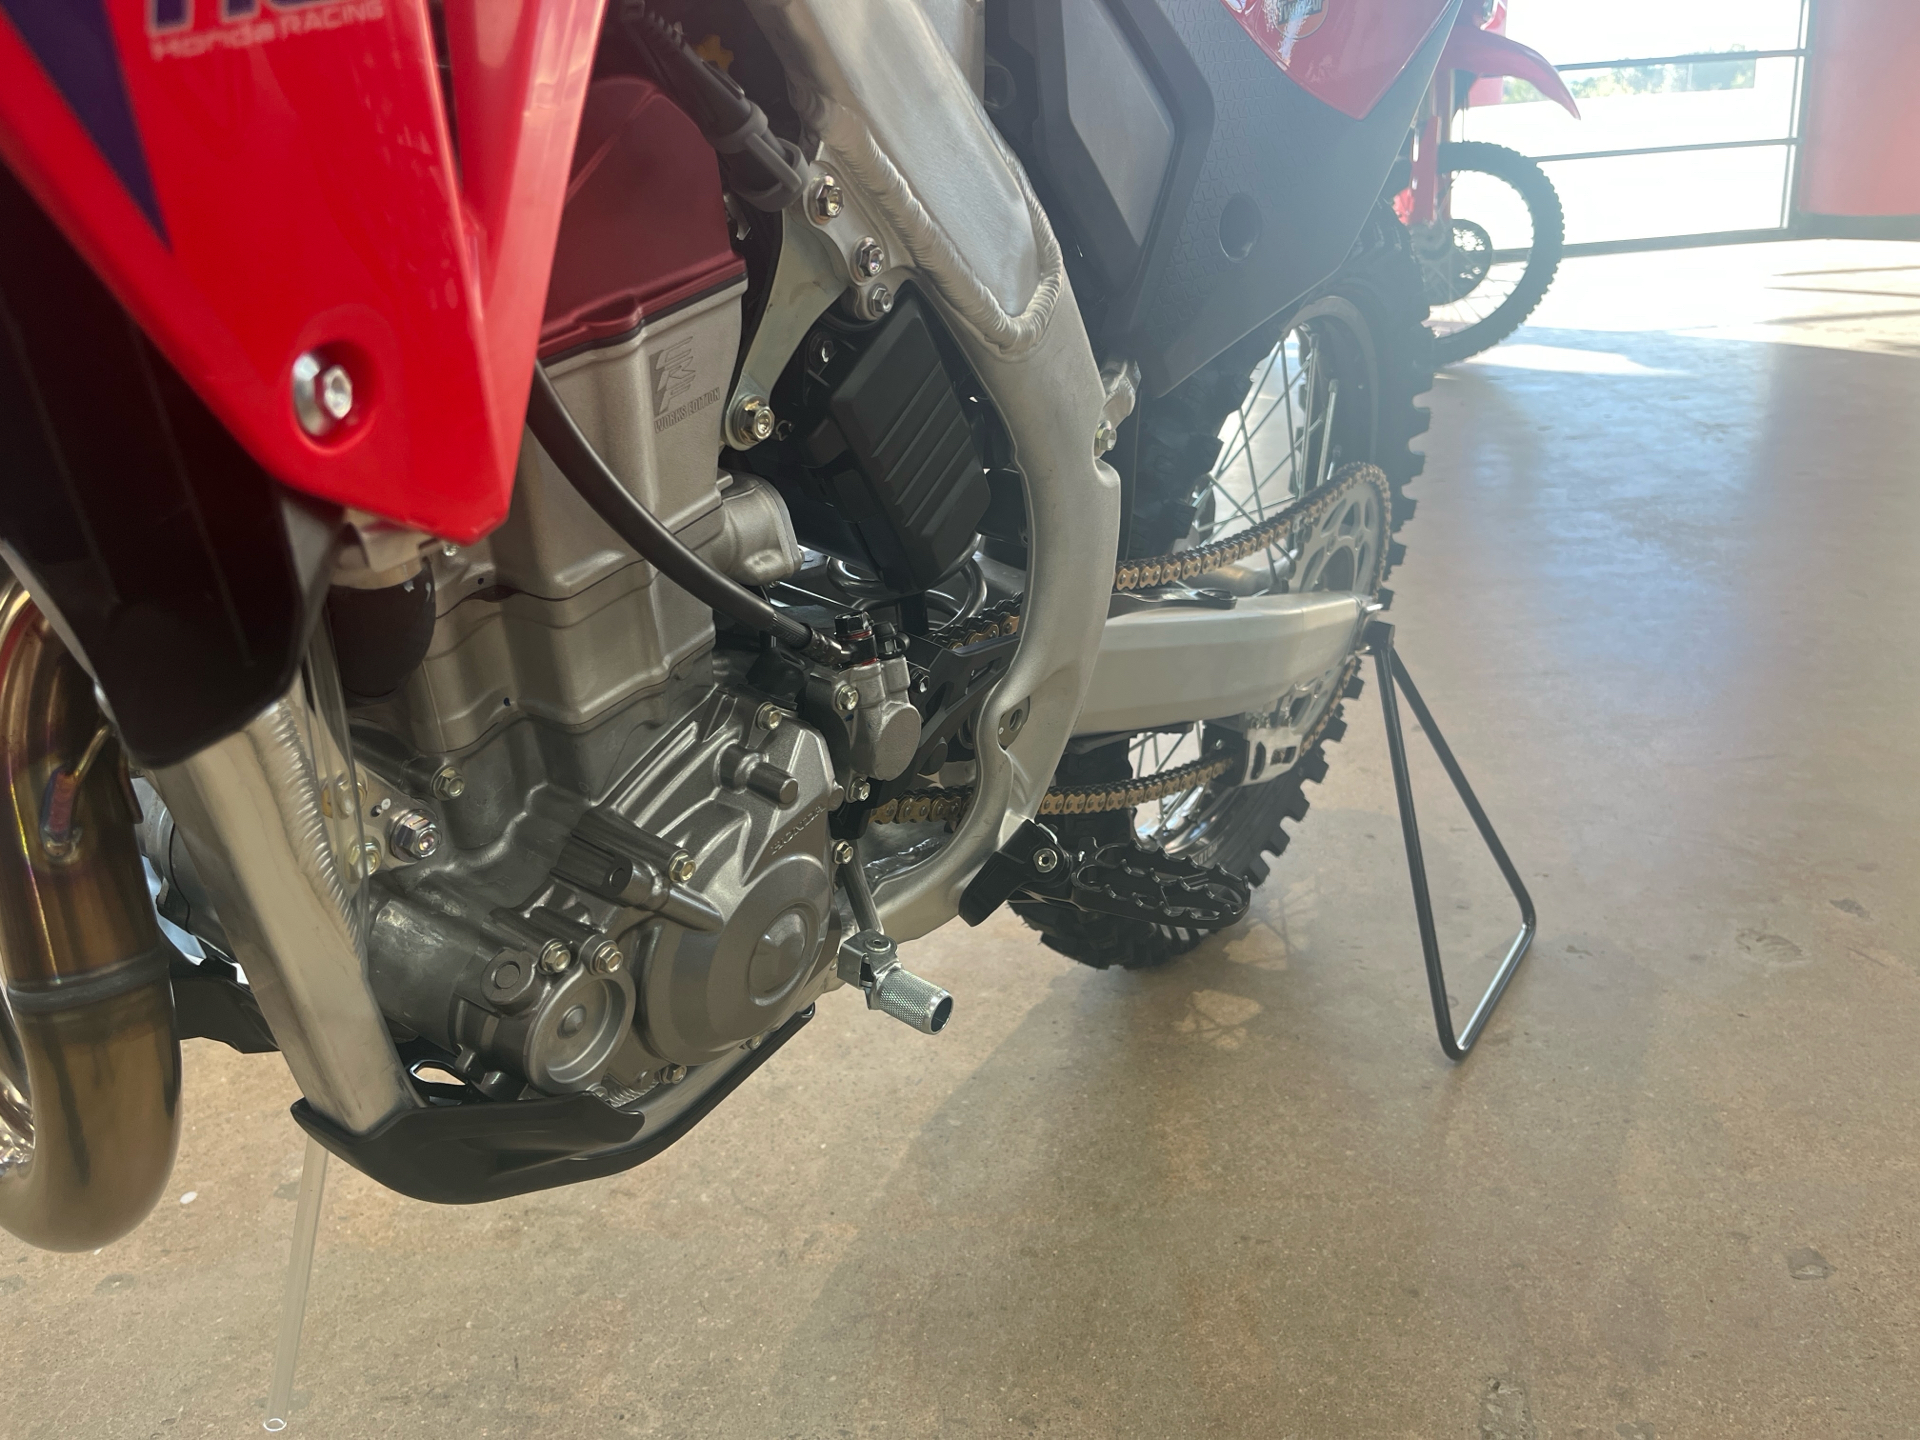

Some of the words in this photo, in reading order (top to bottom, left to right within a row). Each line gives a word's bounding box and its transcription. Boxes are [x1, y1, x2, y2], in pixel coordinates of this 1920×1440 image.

[278, 1, 384, 40] RACING
[654, 404, 688, 434] WORKS
[688, 386, 720, 415] EDITION
[771, 806, 826, 855] HONDA
